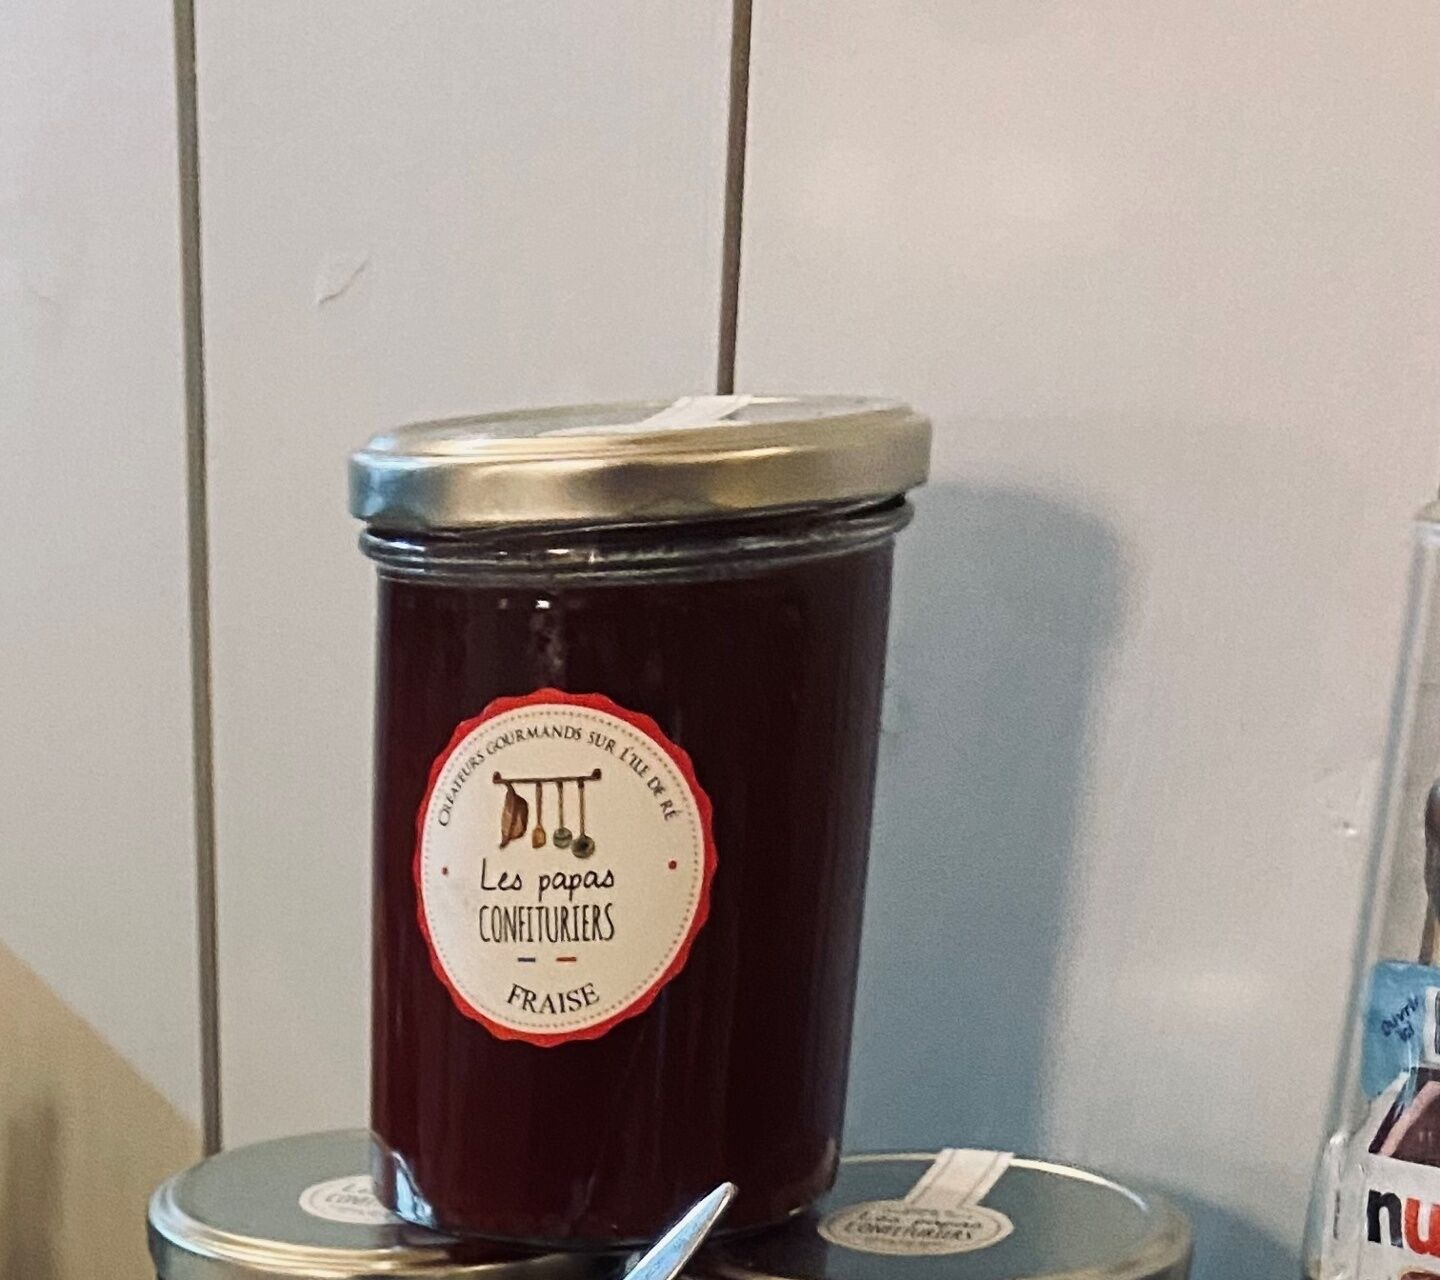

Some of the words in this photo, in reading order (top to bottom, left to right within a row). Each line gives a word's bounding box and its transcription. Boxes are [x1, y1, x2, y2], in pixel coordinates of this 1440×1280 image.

[486, 724, 582, 755] GOURMANDS
[587, 731, 616, 754] SUR
[647, 776, 665, 796] DE
[481, 857, 522, 891] Les
[538, 869, 615, 902] papas
[479, 903, 615, 943] CONFITURIERS
[507, 982, 600, 1014] FRAISE
